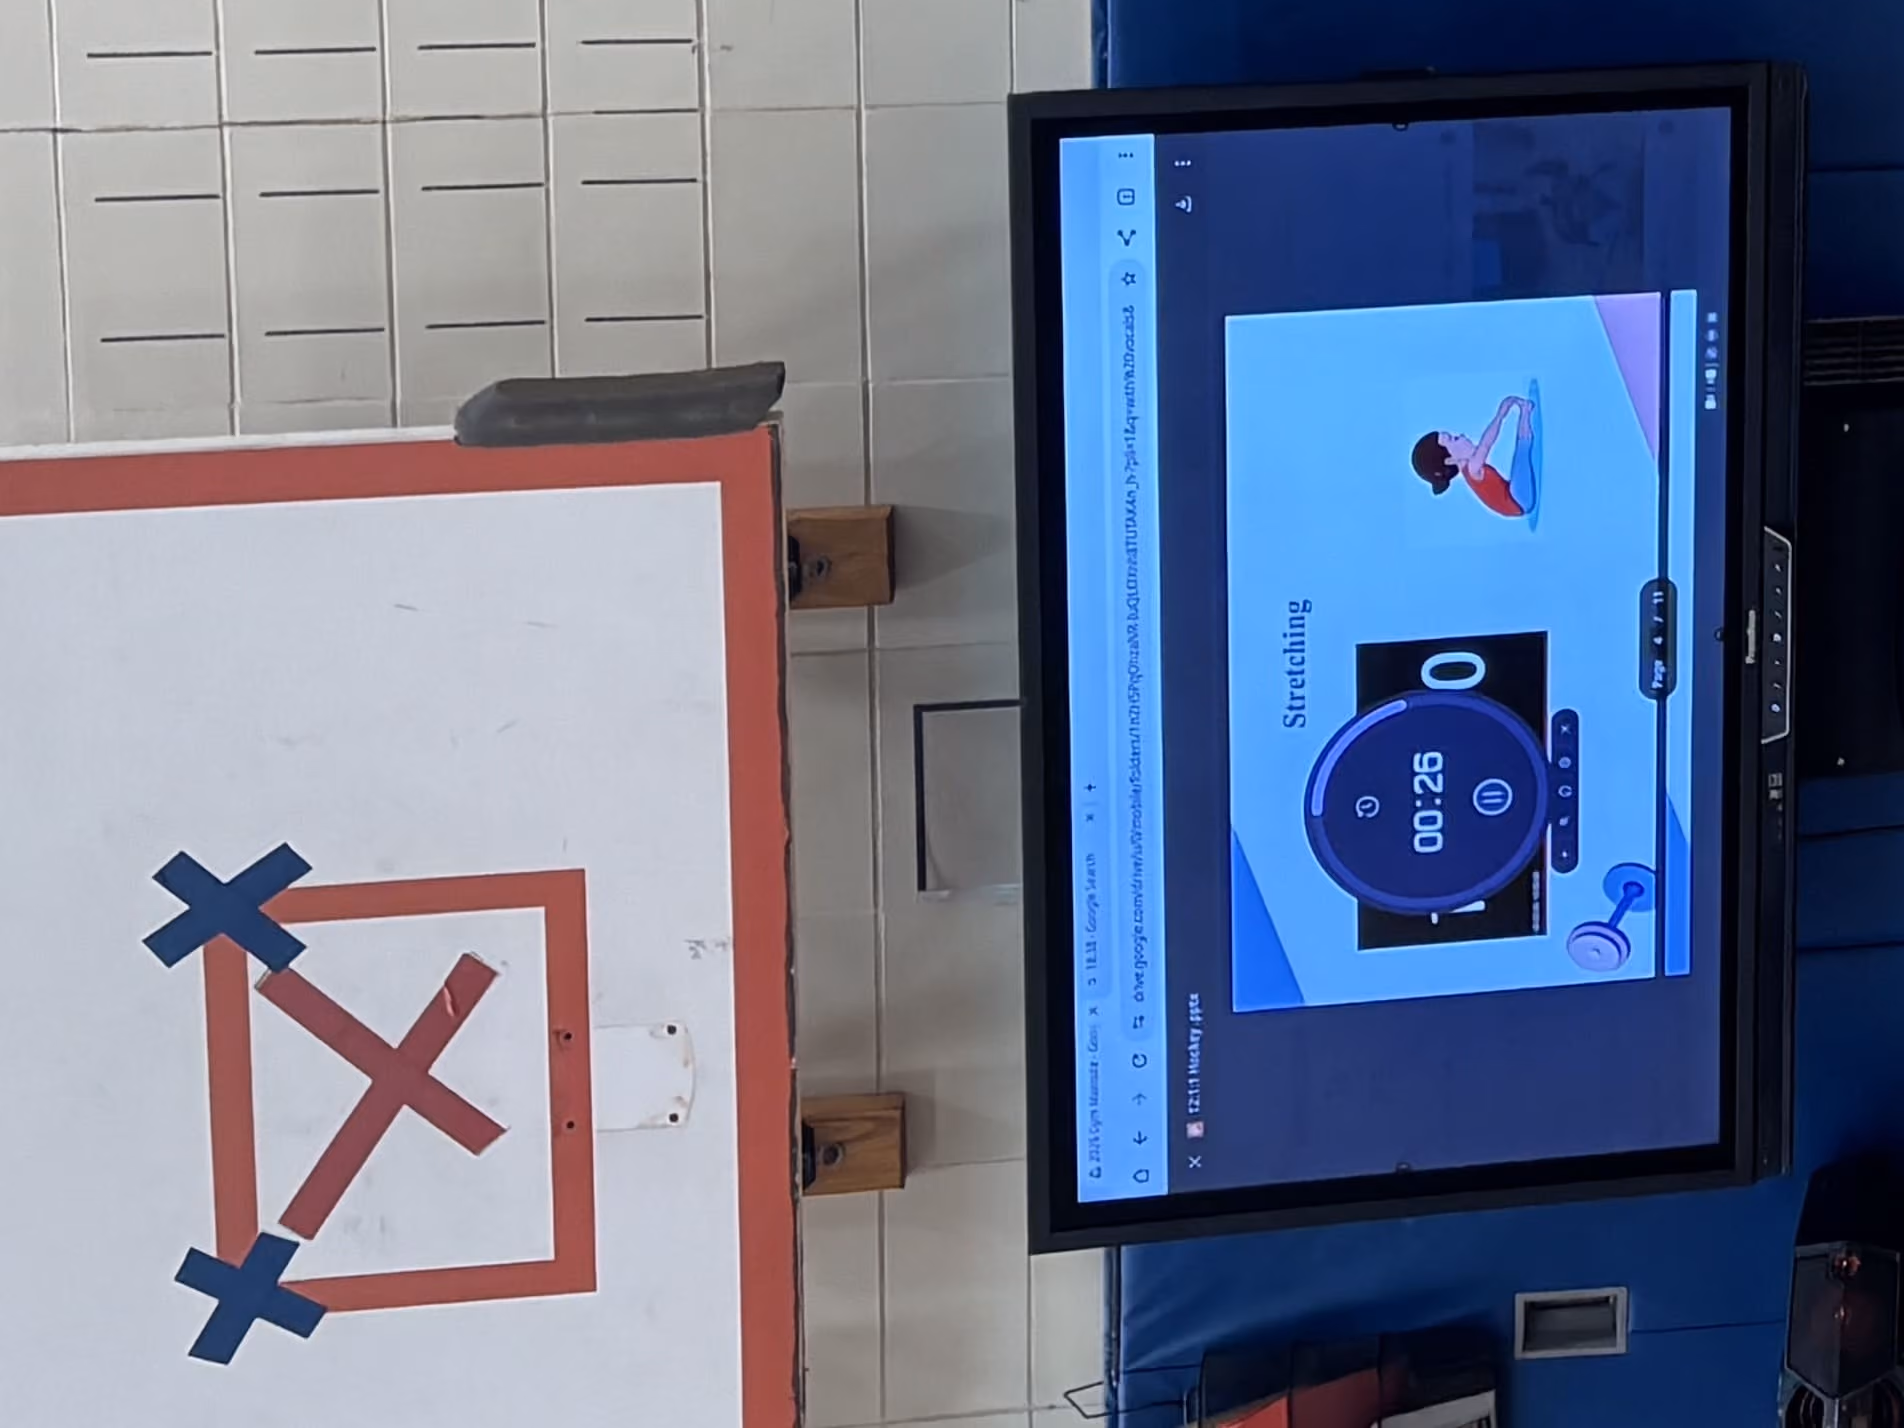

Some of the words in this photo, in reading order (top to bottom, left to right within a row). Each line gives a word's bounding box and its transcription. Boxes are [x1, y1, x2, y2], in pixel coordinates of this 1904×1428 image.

[1282, 599, 1312, 728] Stretching
[1653, 637, 1664, 645] 4
[1413, 751, 1443, 853] 00:26
